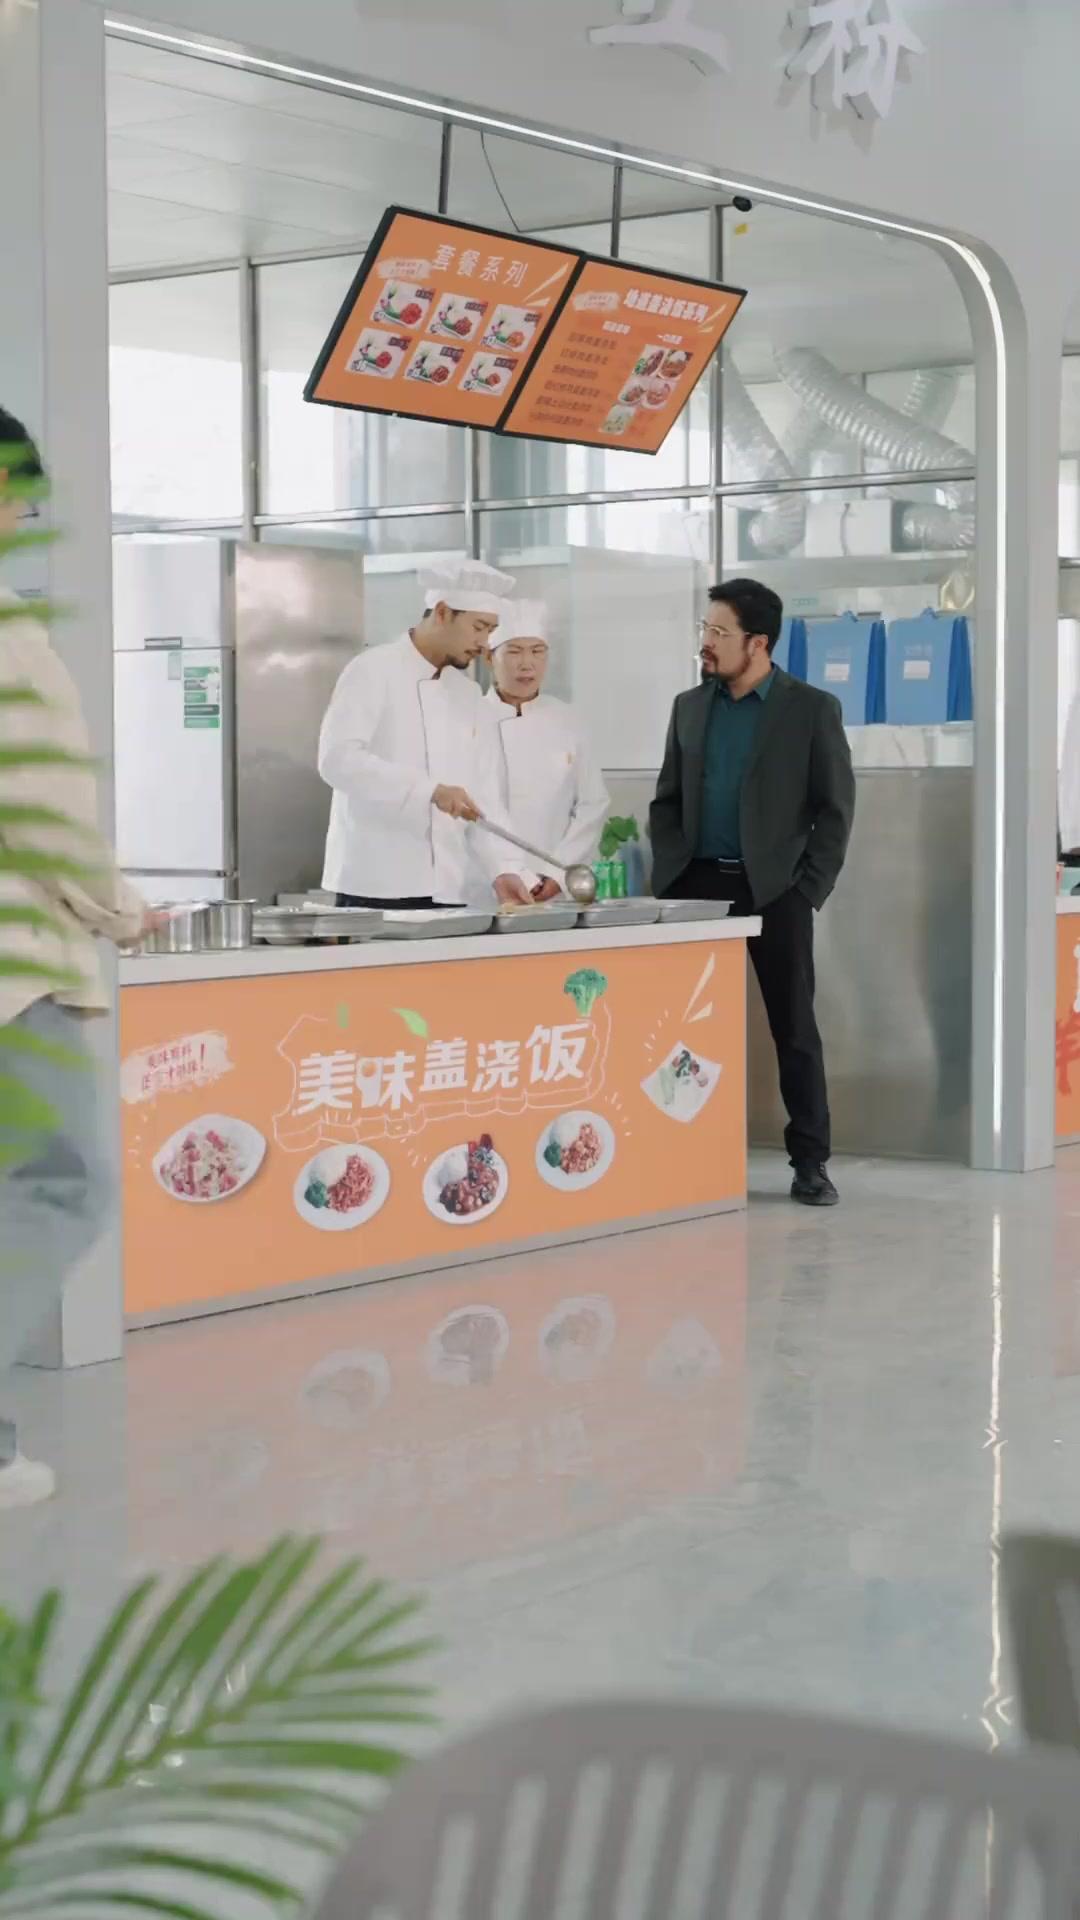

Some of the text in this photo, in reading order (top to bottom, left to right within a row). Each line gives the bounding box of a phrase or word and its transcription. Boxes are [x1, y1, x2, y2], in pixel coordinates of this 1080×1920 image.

[431, 244, 529, 287] 套餐系列
[295, 1023, 592, 1116] 美味盖浇饭
